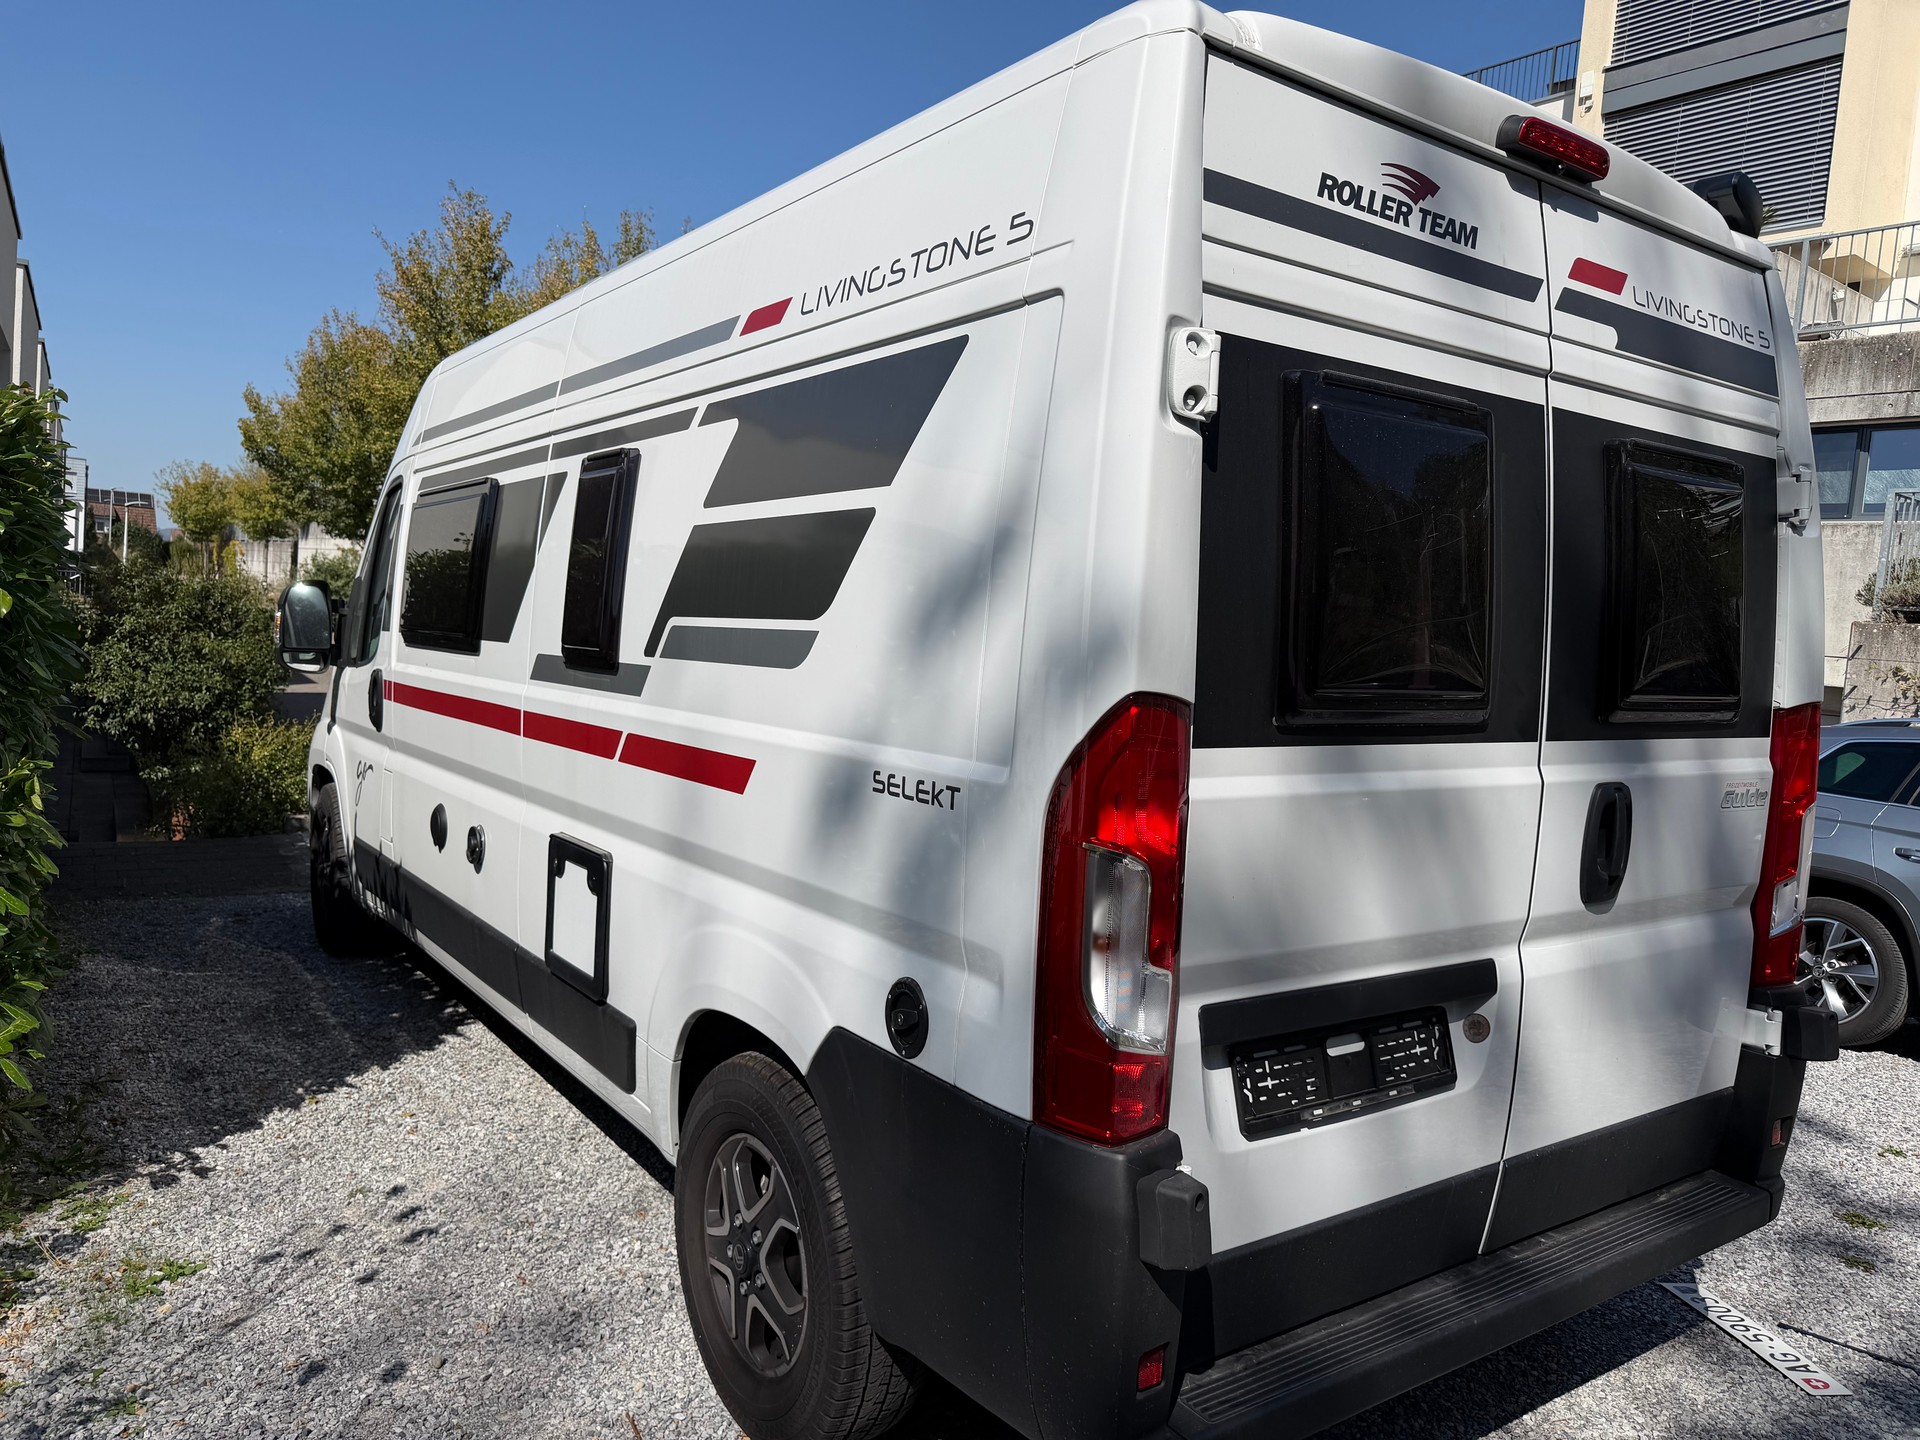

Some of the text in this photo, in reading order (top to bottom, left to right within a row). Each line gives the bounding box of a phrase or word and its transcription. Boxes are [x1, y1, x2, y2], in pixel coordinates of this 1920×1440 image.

[1317, 172, 1479, 250] ROLLER TEAM
[800, 211, 1034, 316] LIVINGSTONE 5
[1632, 285, 1771, 350] LIVINGSTONE 5
[872, 770, 961, 811] SELEKT
